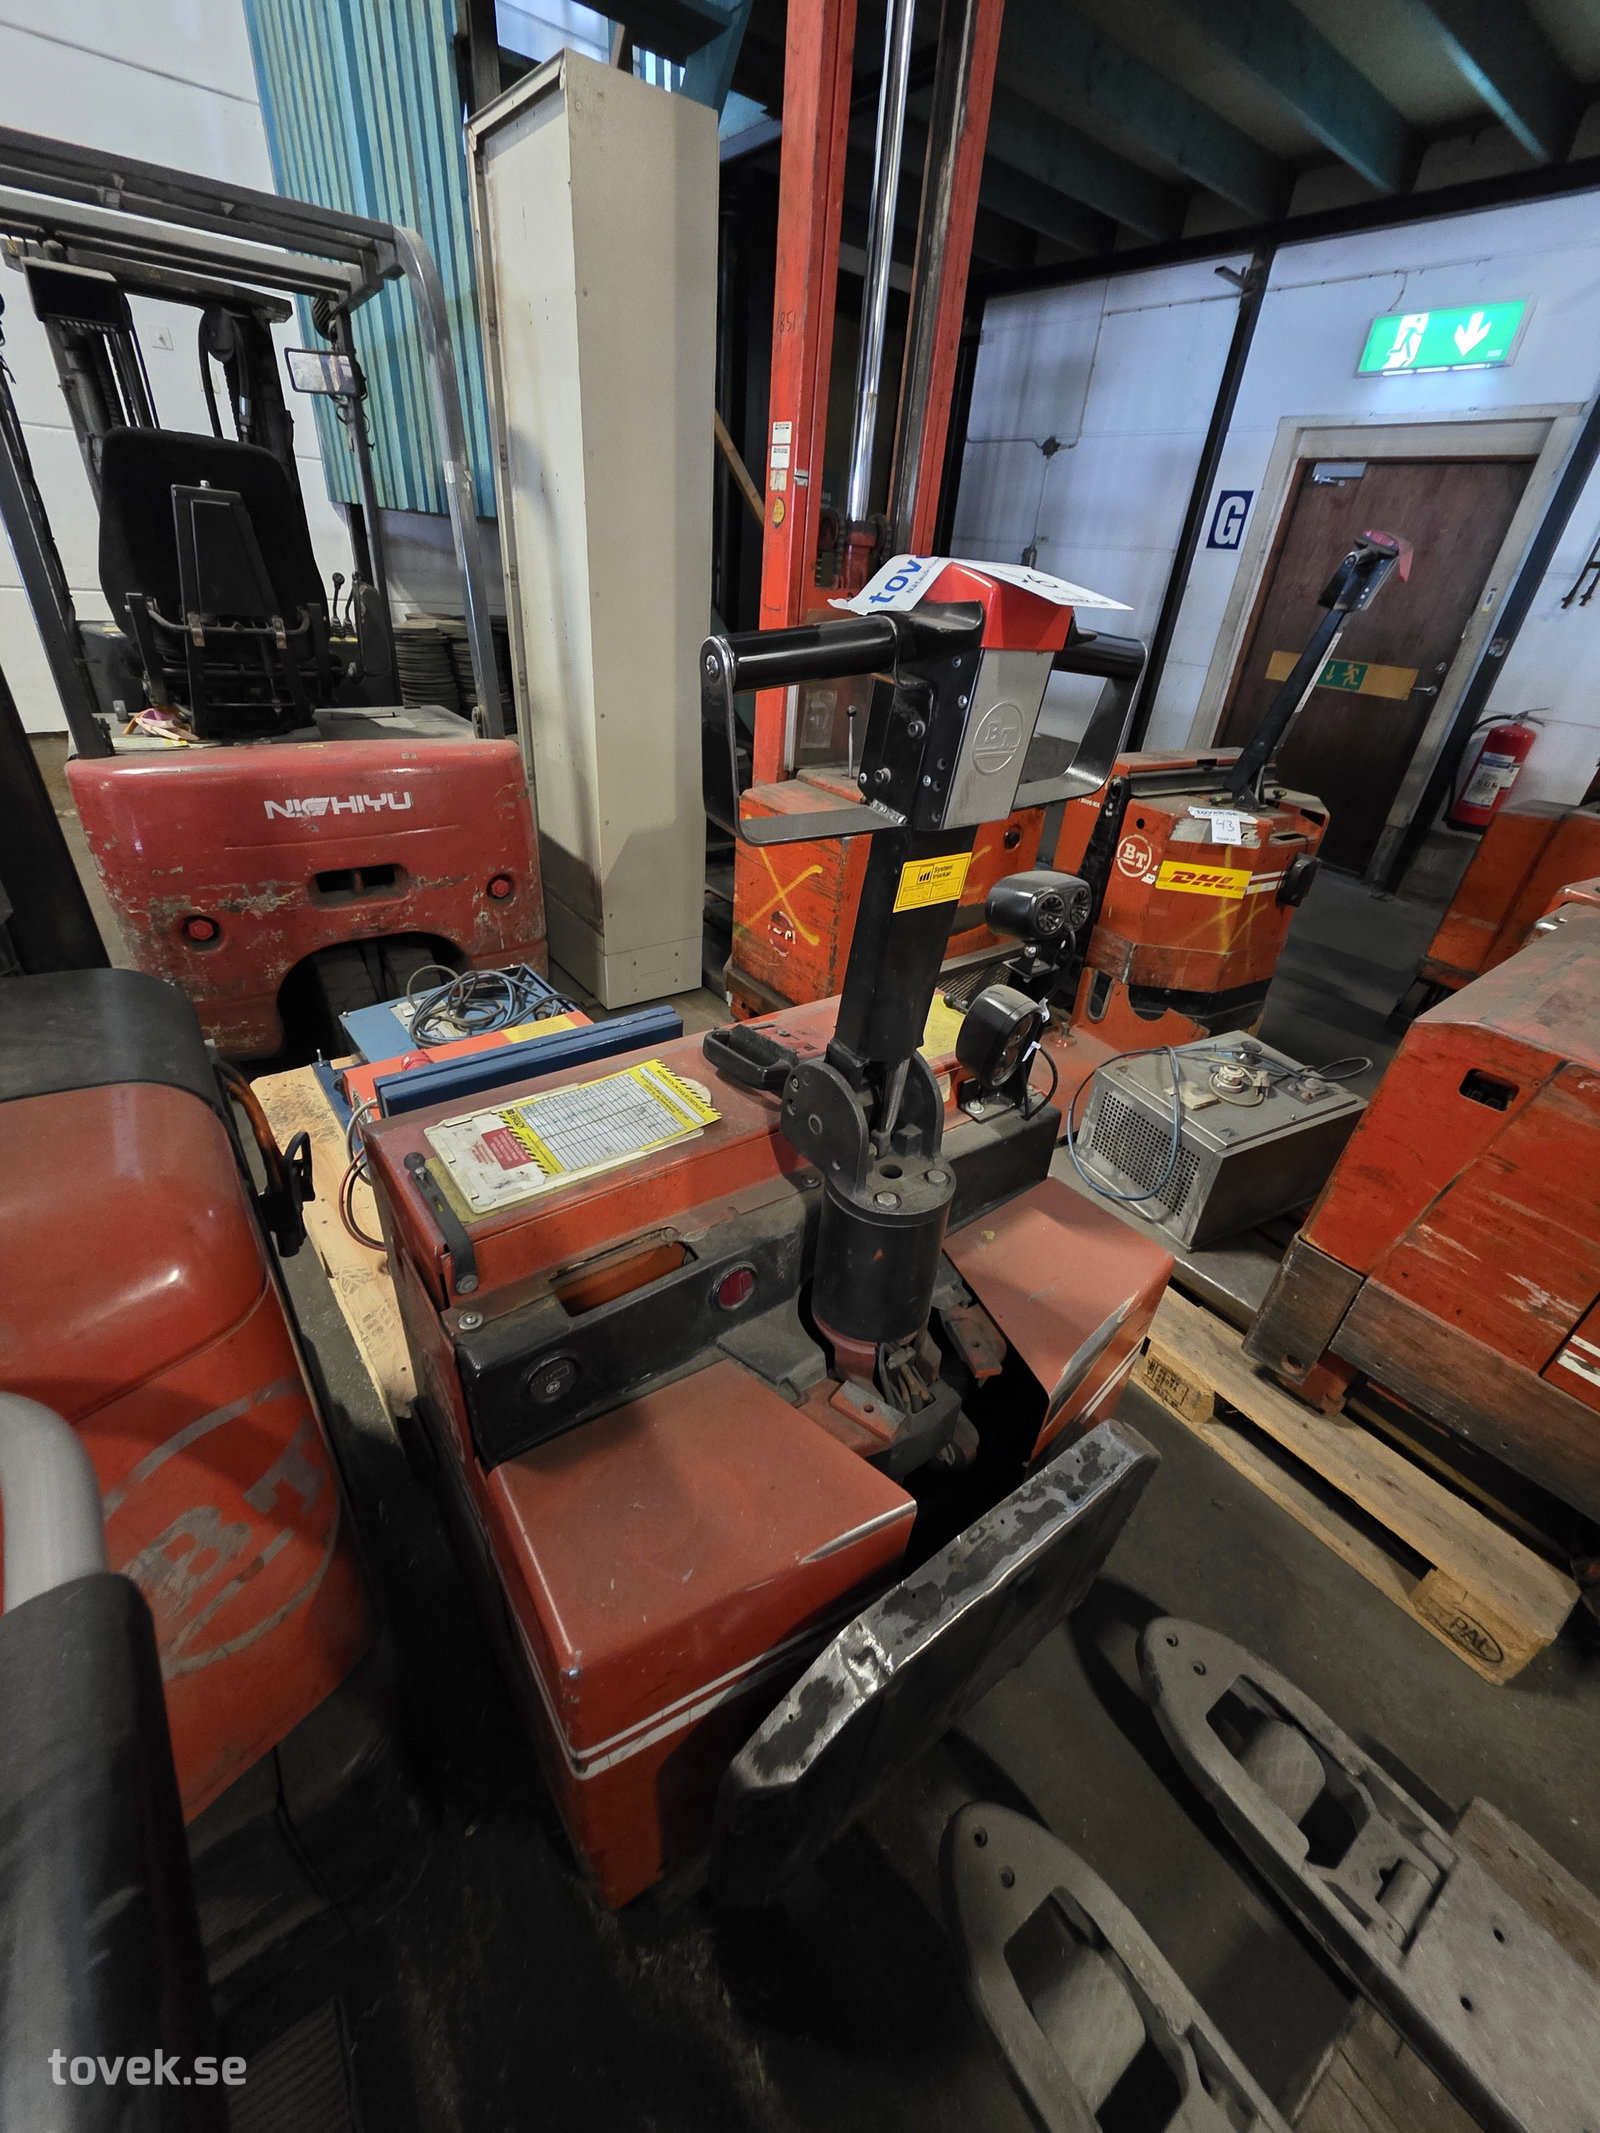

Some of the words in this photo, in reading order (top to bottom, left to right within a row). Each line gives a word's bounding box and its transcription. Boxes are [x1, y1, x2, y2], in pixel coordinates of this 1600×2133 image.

[1214, 495, 1246, 545] G
[263, 791, 414, 820] NICHIYU
[1215, 817, 1235, 832] 43
[1122, 843, 1147, 869] BT
[1169, 870, 1235, 891] DHL
[119, 1414, 331, 1620] BT
